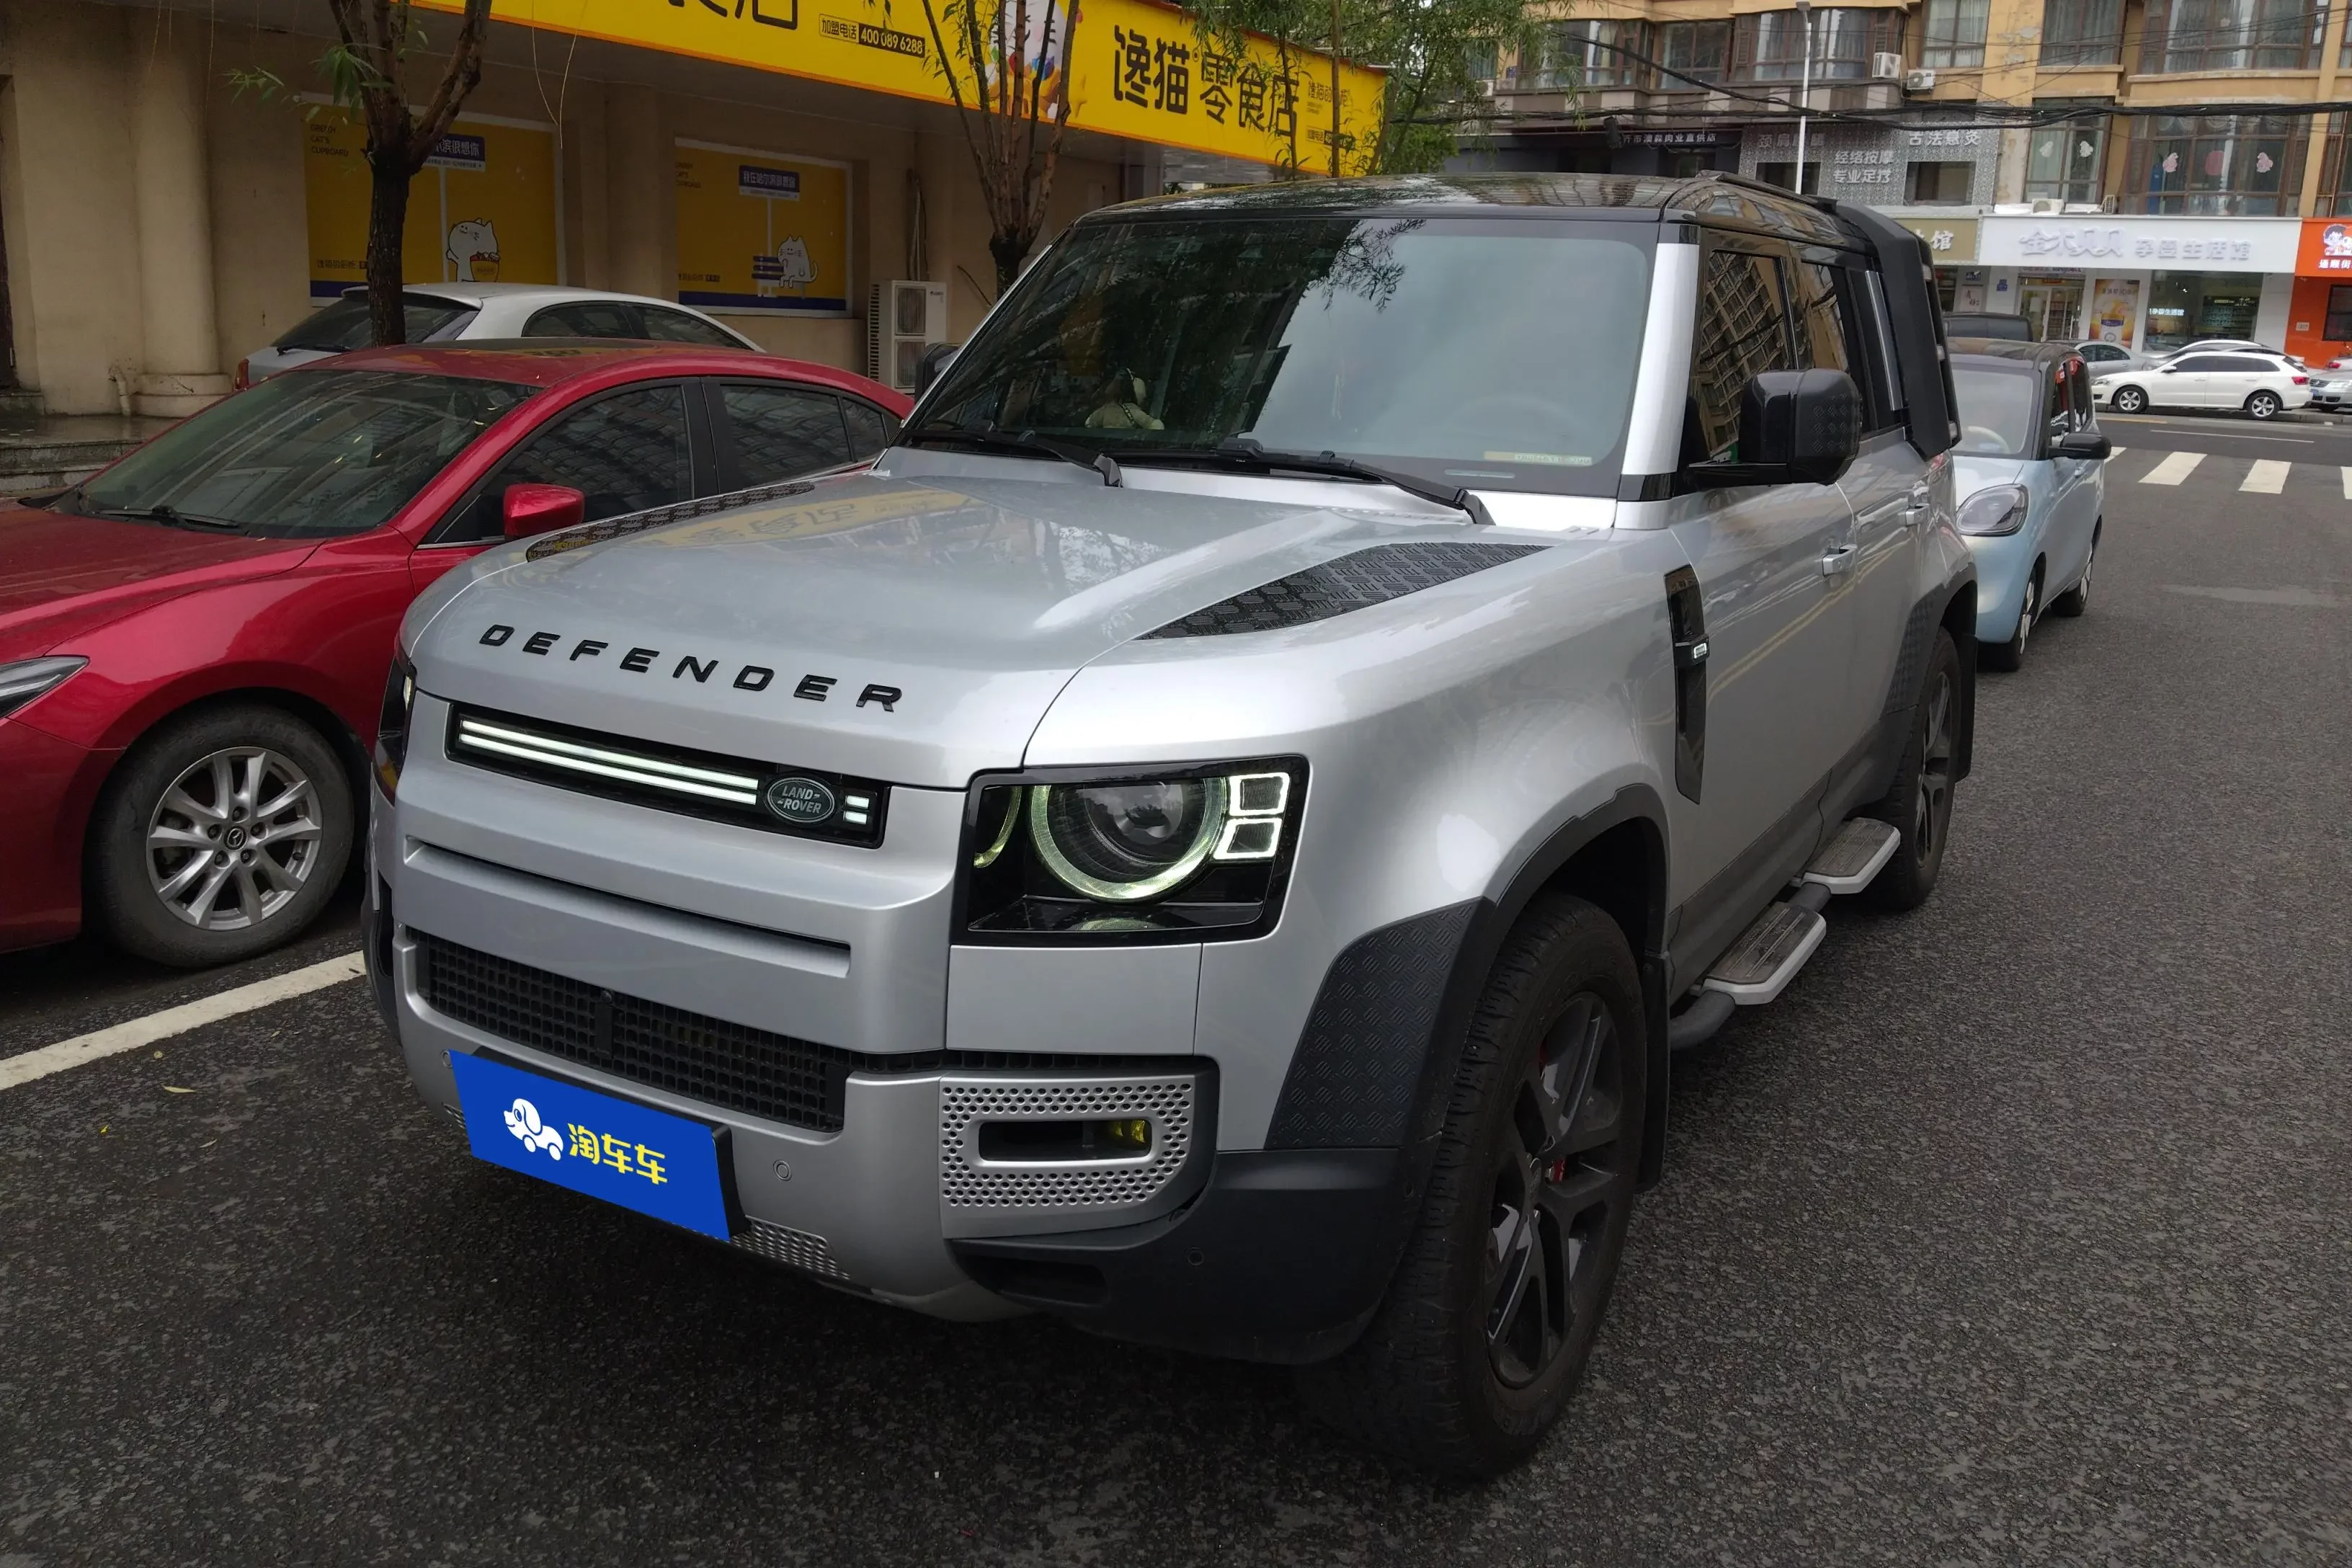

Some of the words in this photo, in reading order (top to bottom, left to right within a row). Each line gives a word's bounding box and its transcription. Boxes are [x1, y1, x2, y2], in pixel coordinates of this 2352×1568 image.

[821, 19, 858, 40] 加盟电话
[860, 27, 879, 45] 400
[881, 32, 899, 49] 089
[900, 39, 924, 55] 6288
[1834, 150, 1893, 165] 经络按摩
[1832, 169, 1892, 184] 专业足疗
[478, 624, 903, 713] DEFENDER
[782, 785, 814, 800] LAND
[783, 798, 821, 814] ROVER
